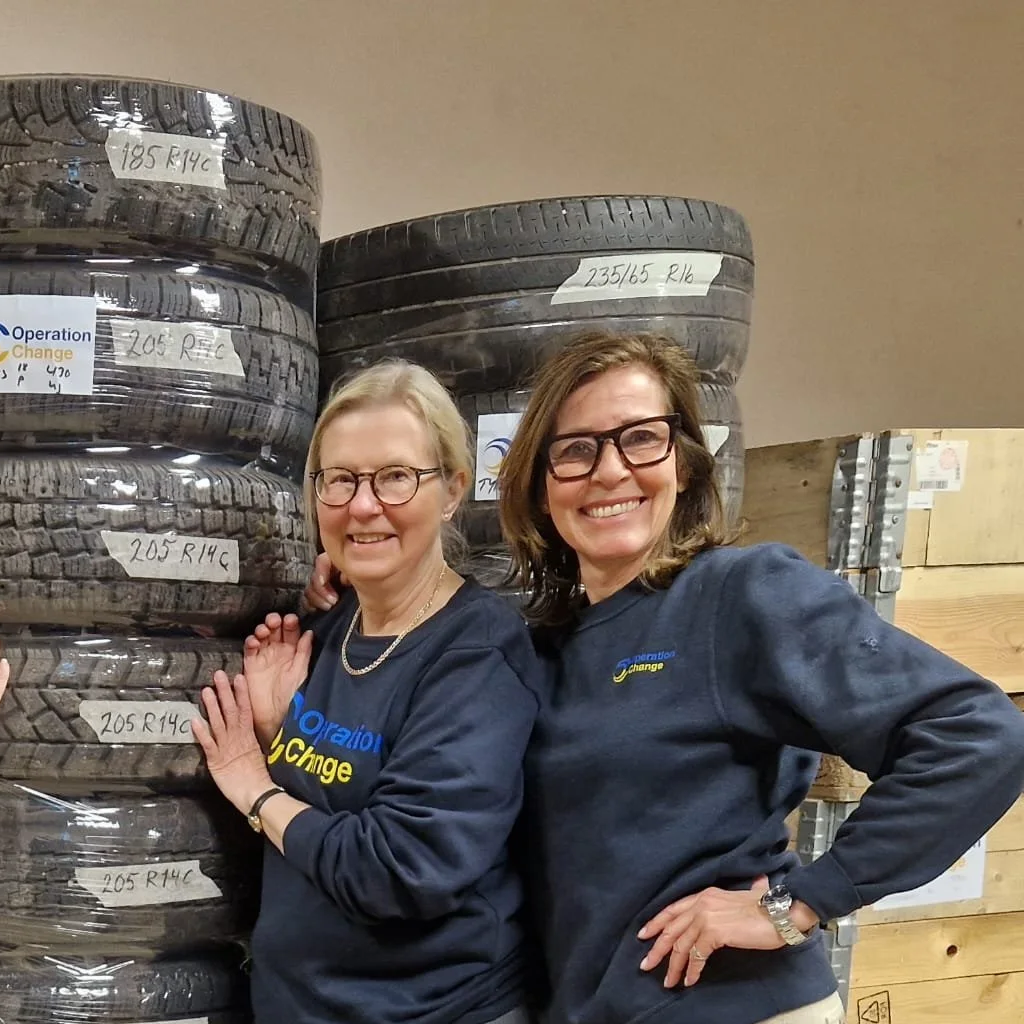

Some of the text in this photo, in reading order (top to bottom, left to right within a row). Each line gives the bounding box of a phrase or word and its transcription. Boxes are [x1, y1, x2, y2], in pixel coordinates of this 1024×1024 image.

[121, 142, 163, 170] 185
[584, 262, 694, 289] 235/65 R16
[12, 326, 91, 343] Operation
[127, 329, 170, 357] 205
[12, 344, 73, 362] Change
[46, 364, 71, 378] 470
[478, 477, 497, 494] TY
[130, 538, 176, 563] 205
[628, 662, 664, 674] Change
[100, 711, 192, 737] 205 R14C
[102, 868, 193, 894] 205 R14C
